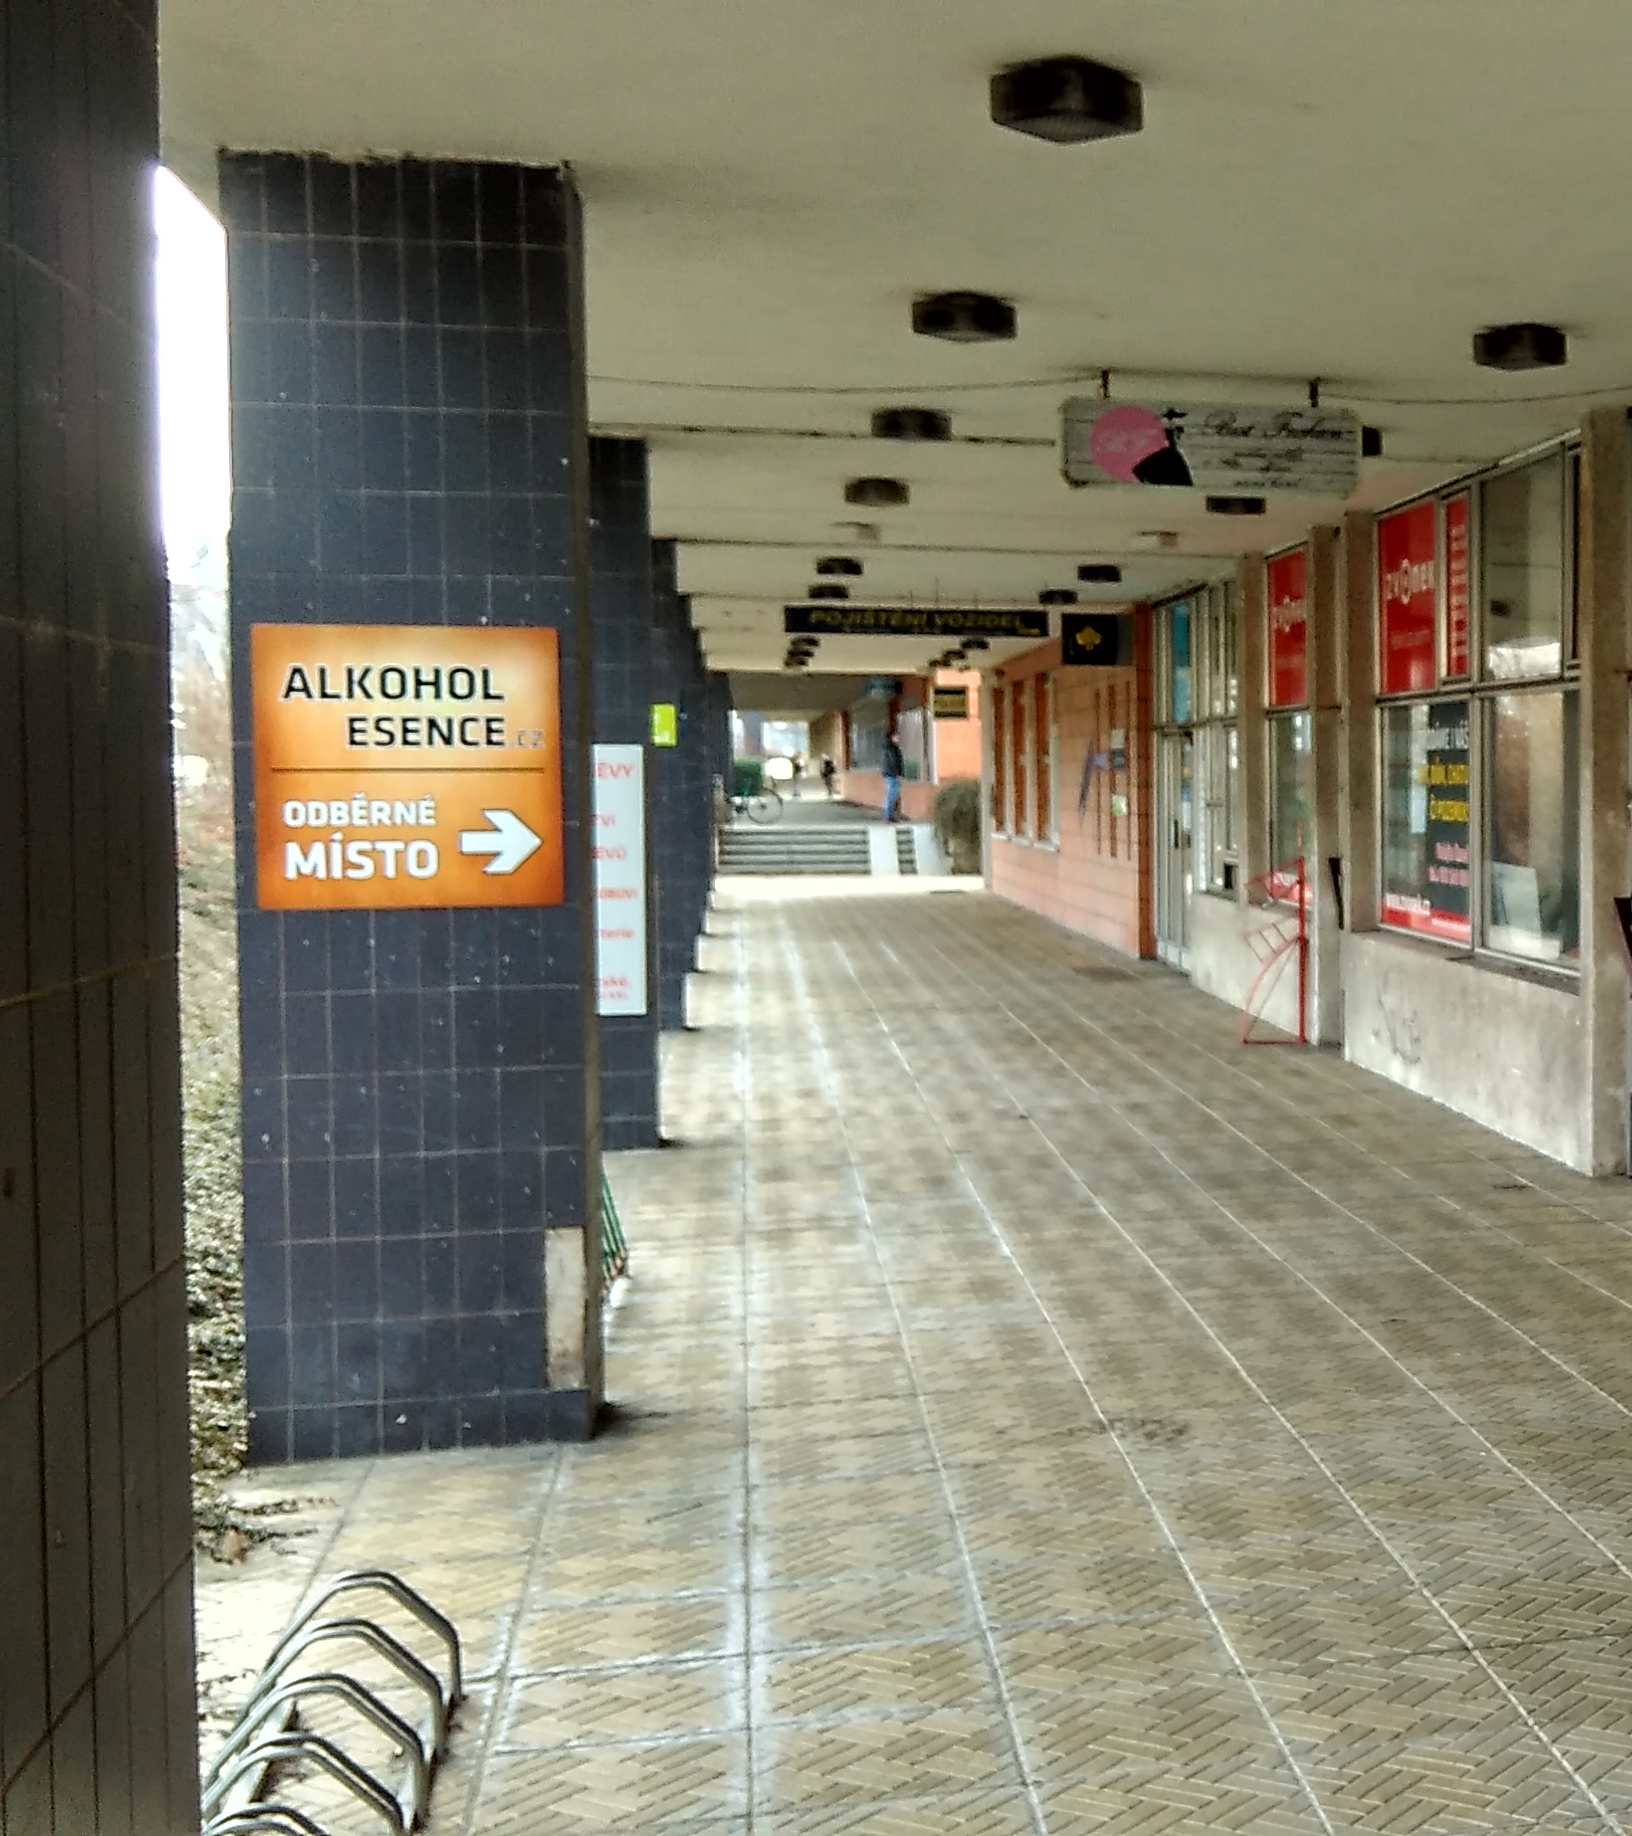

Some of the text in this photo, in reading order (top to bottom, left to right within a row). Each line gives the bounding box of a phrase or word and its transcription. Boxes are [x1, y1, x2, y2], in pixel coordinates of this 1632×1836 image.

[282, 665, 506, 701] ALKOHOL
[282, 793, 438, 828] ODBĚRNÉ
[283, 832, 439, 881] MÍSTO
